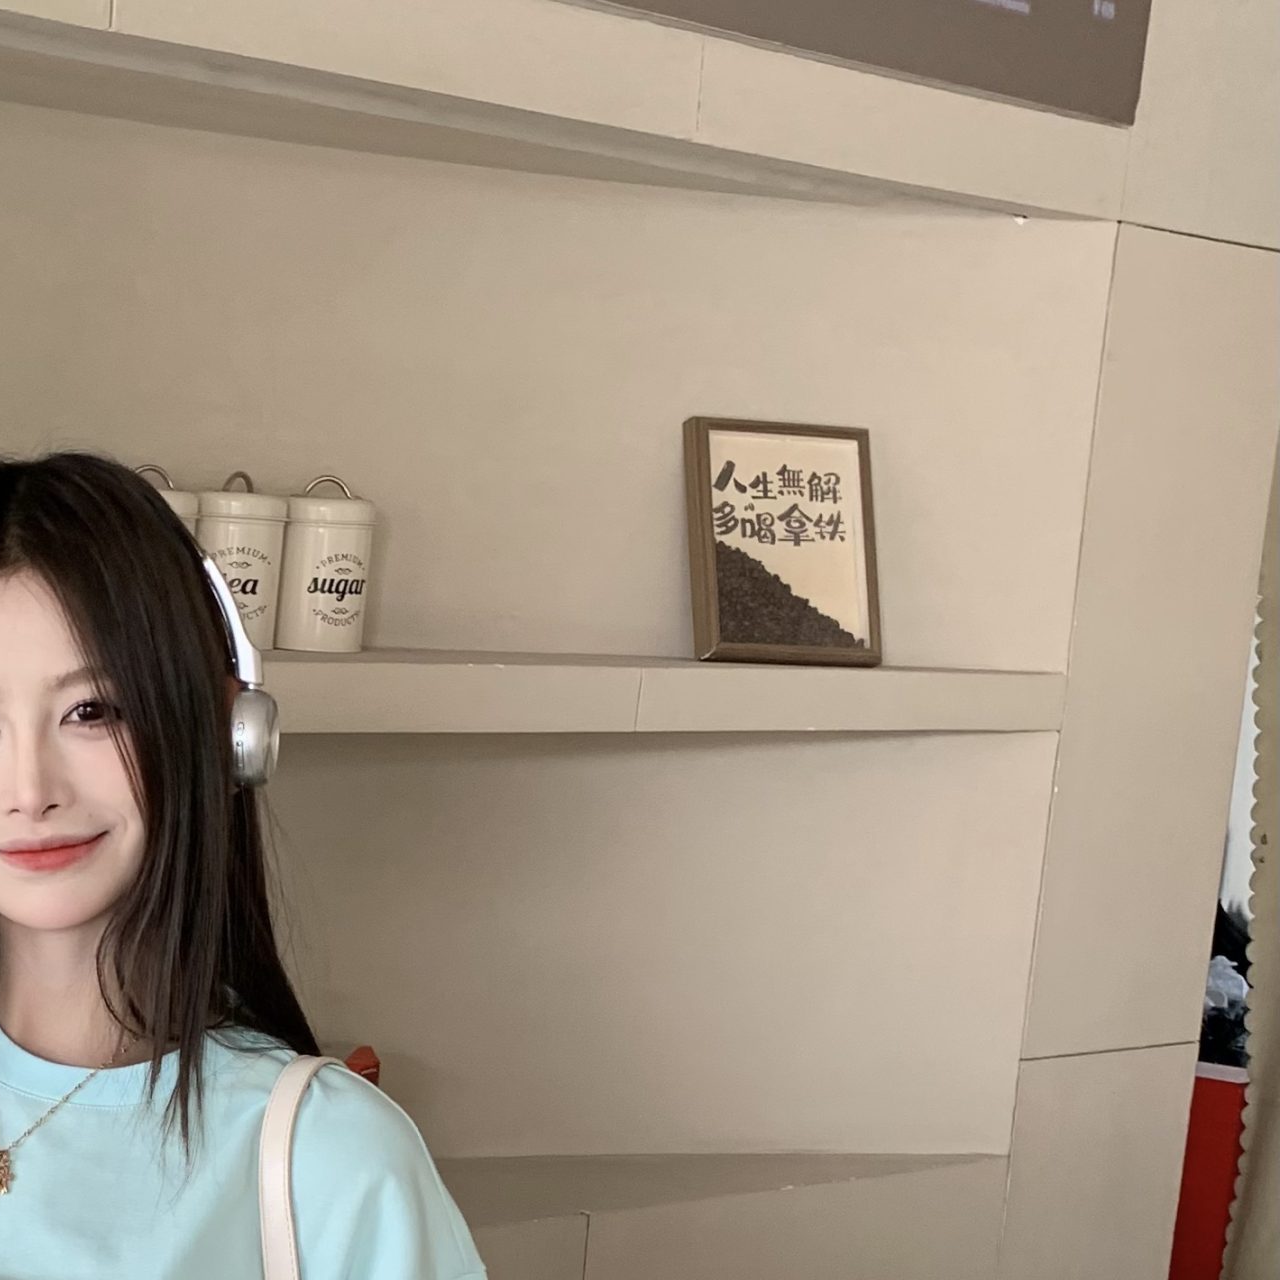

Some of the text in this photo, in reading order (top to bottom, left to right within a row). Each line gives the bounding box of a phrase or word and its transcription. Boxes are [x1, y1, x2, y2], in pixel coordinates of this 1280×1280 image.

[713, 460, 843, 504] 人生無解
[213, 547, 268, 563] PREMIUM
[321, 553, 364, 568] PREMIUM
[224, 574, 259, 596] ea
[307, 577, 366, 602] sugar
